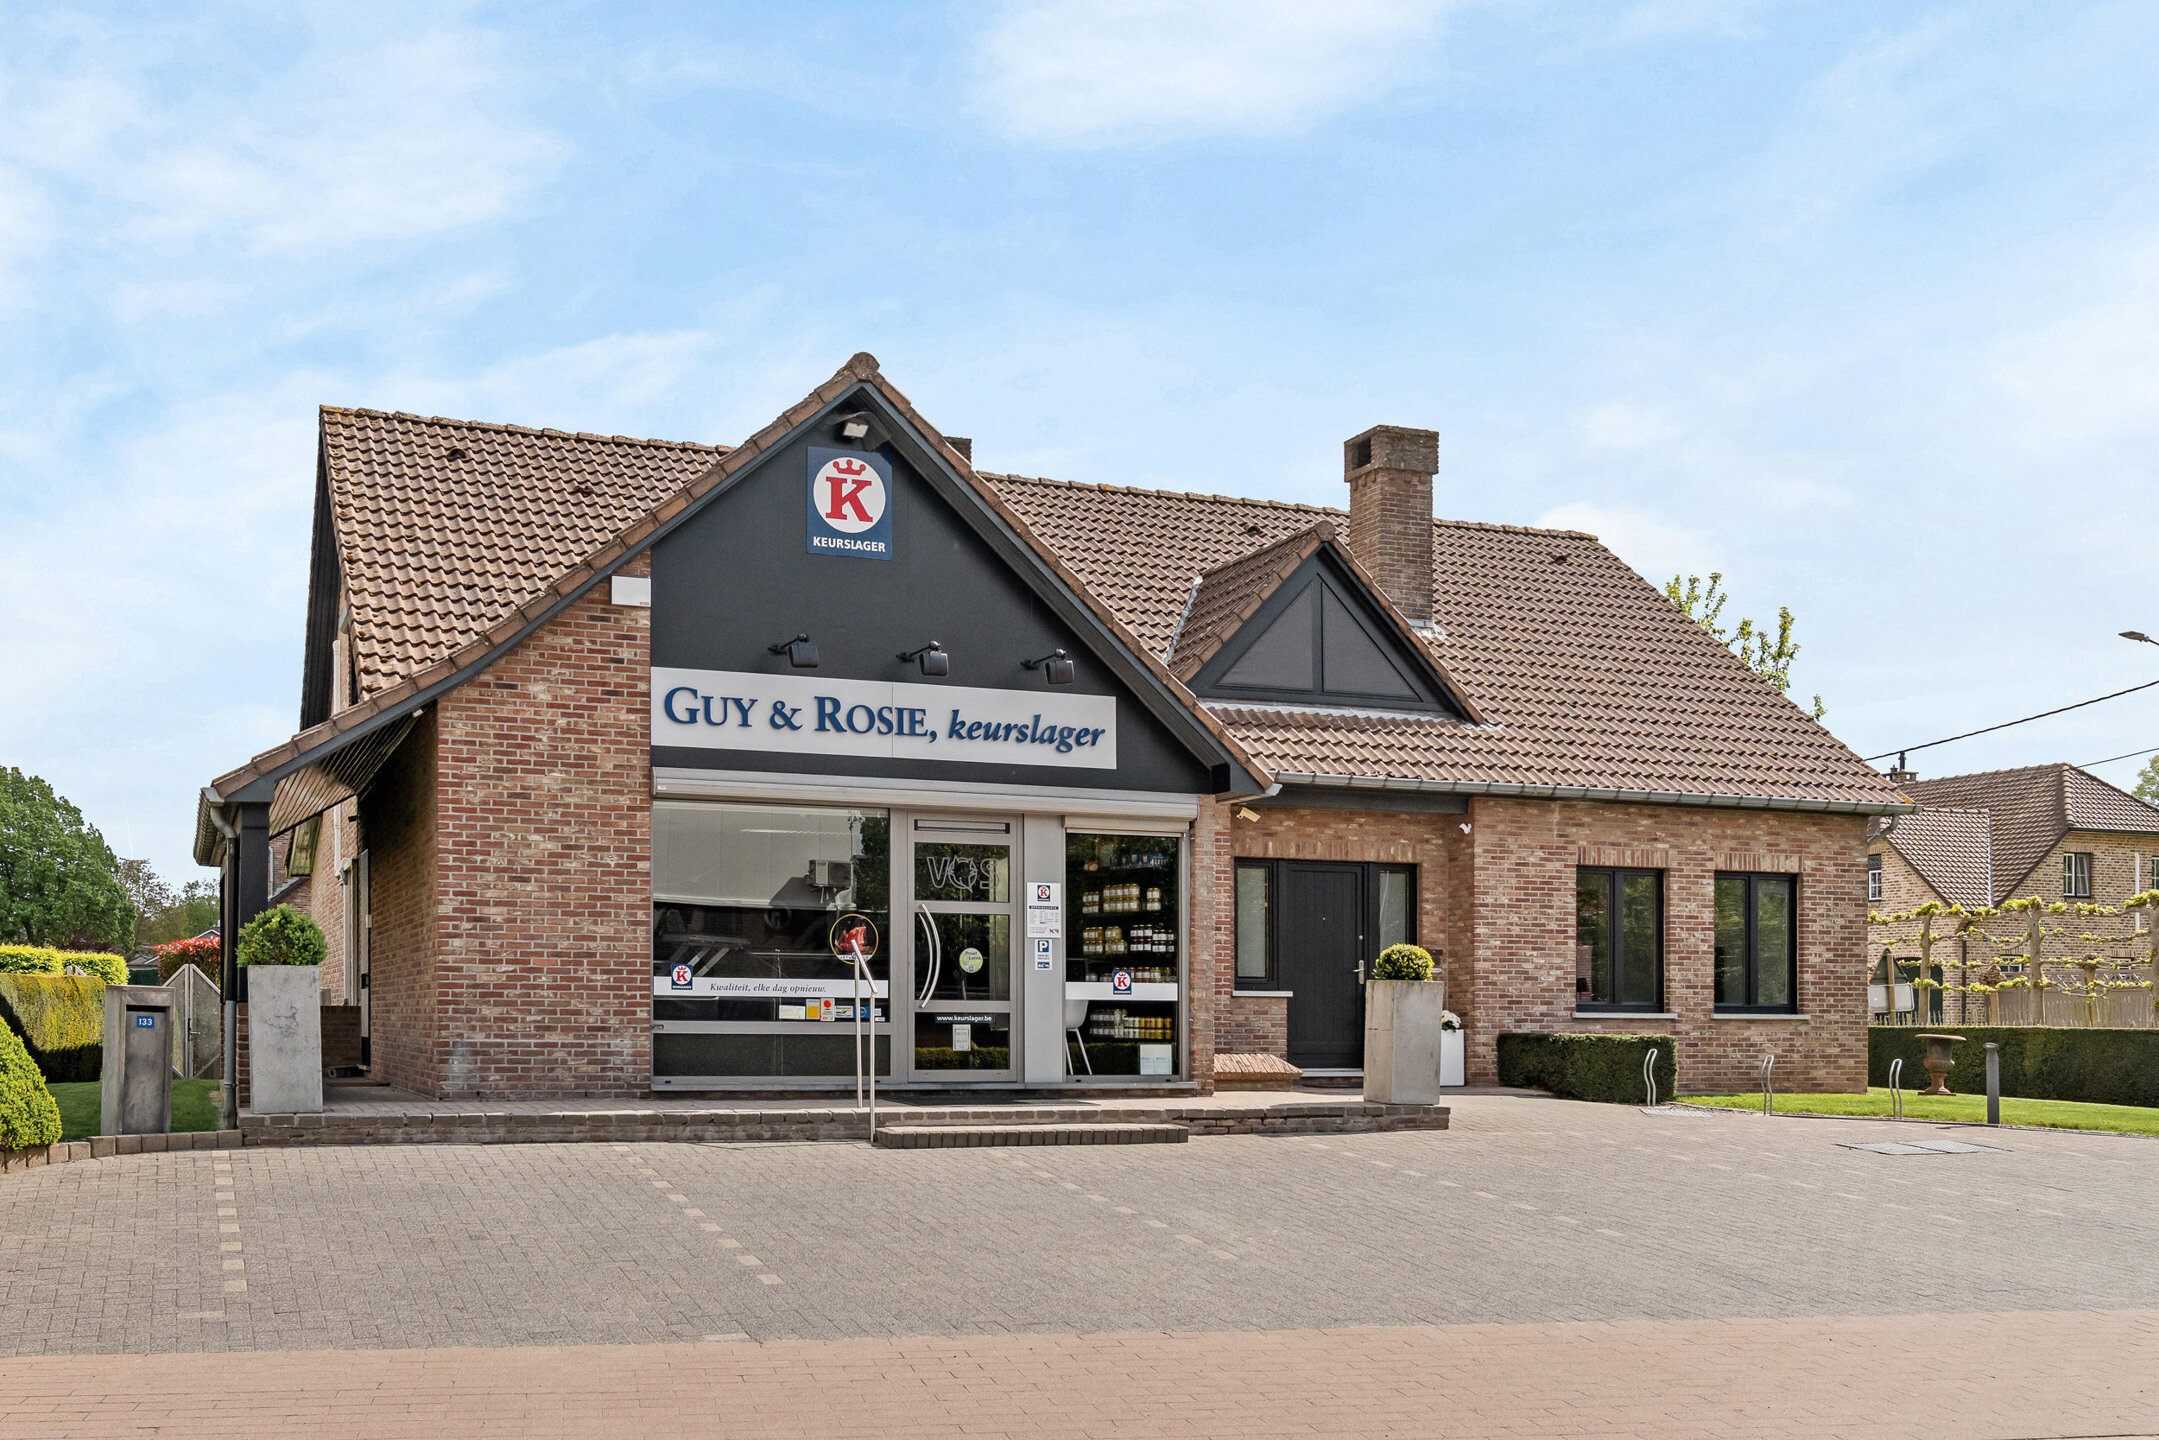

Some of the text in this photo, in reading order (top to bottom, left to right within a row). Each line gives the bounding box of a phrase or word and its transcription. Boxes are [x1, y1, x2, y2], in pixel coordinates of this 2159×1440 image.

[825, 476, 874, 523] K
[813, 535, 886, 553] KEURSLAGER
[664, 686, 1106, 754] GUY & ROSIE, keurslager
[1039, 941, 1048, 952] P
[675, 970, 689, 982] K
[1116, 976, 1128, 988] K
[710, 983, 827, 994] Kwaliteit, elke dag opnieuw.
[138, 1018, 153, 1026] 133
[936, 1015, 993, 1023] www.keurslager.be
